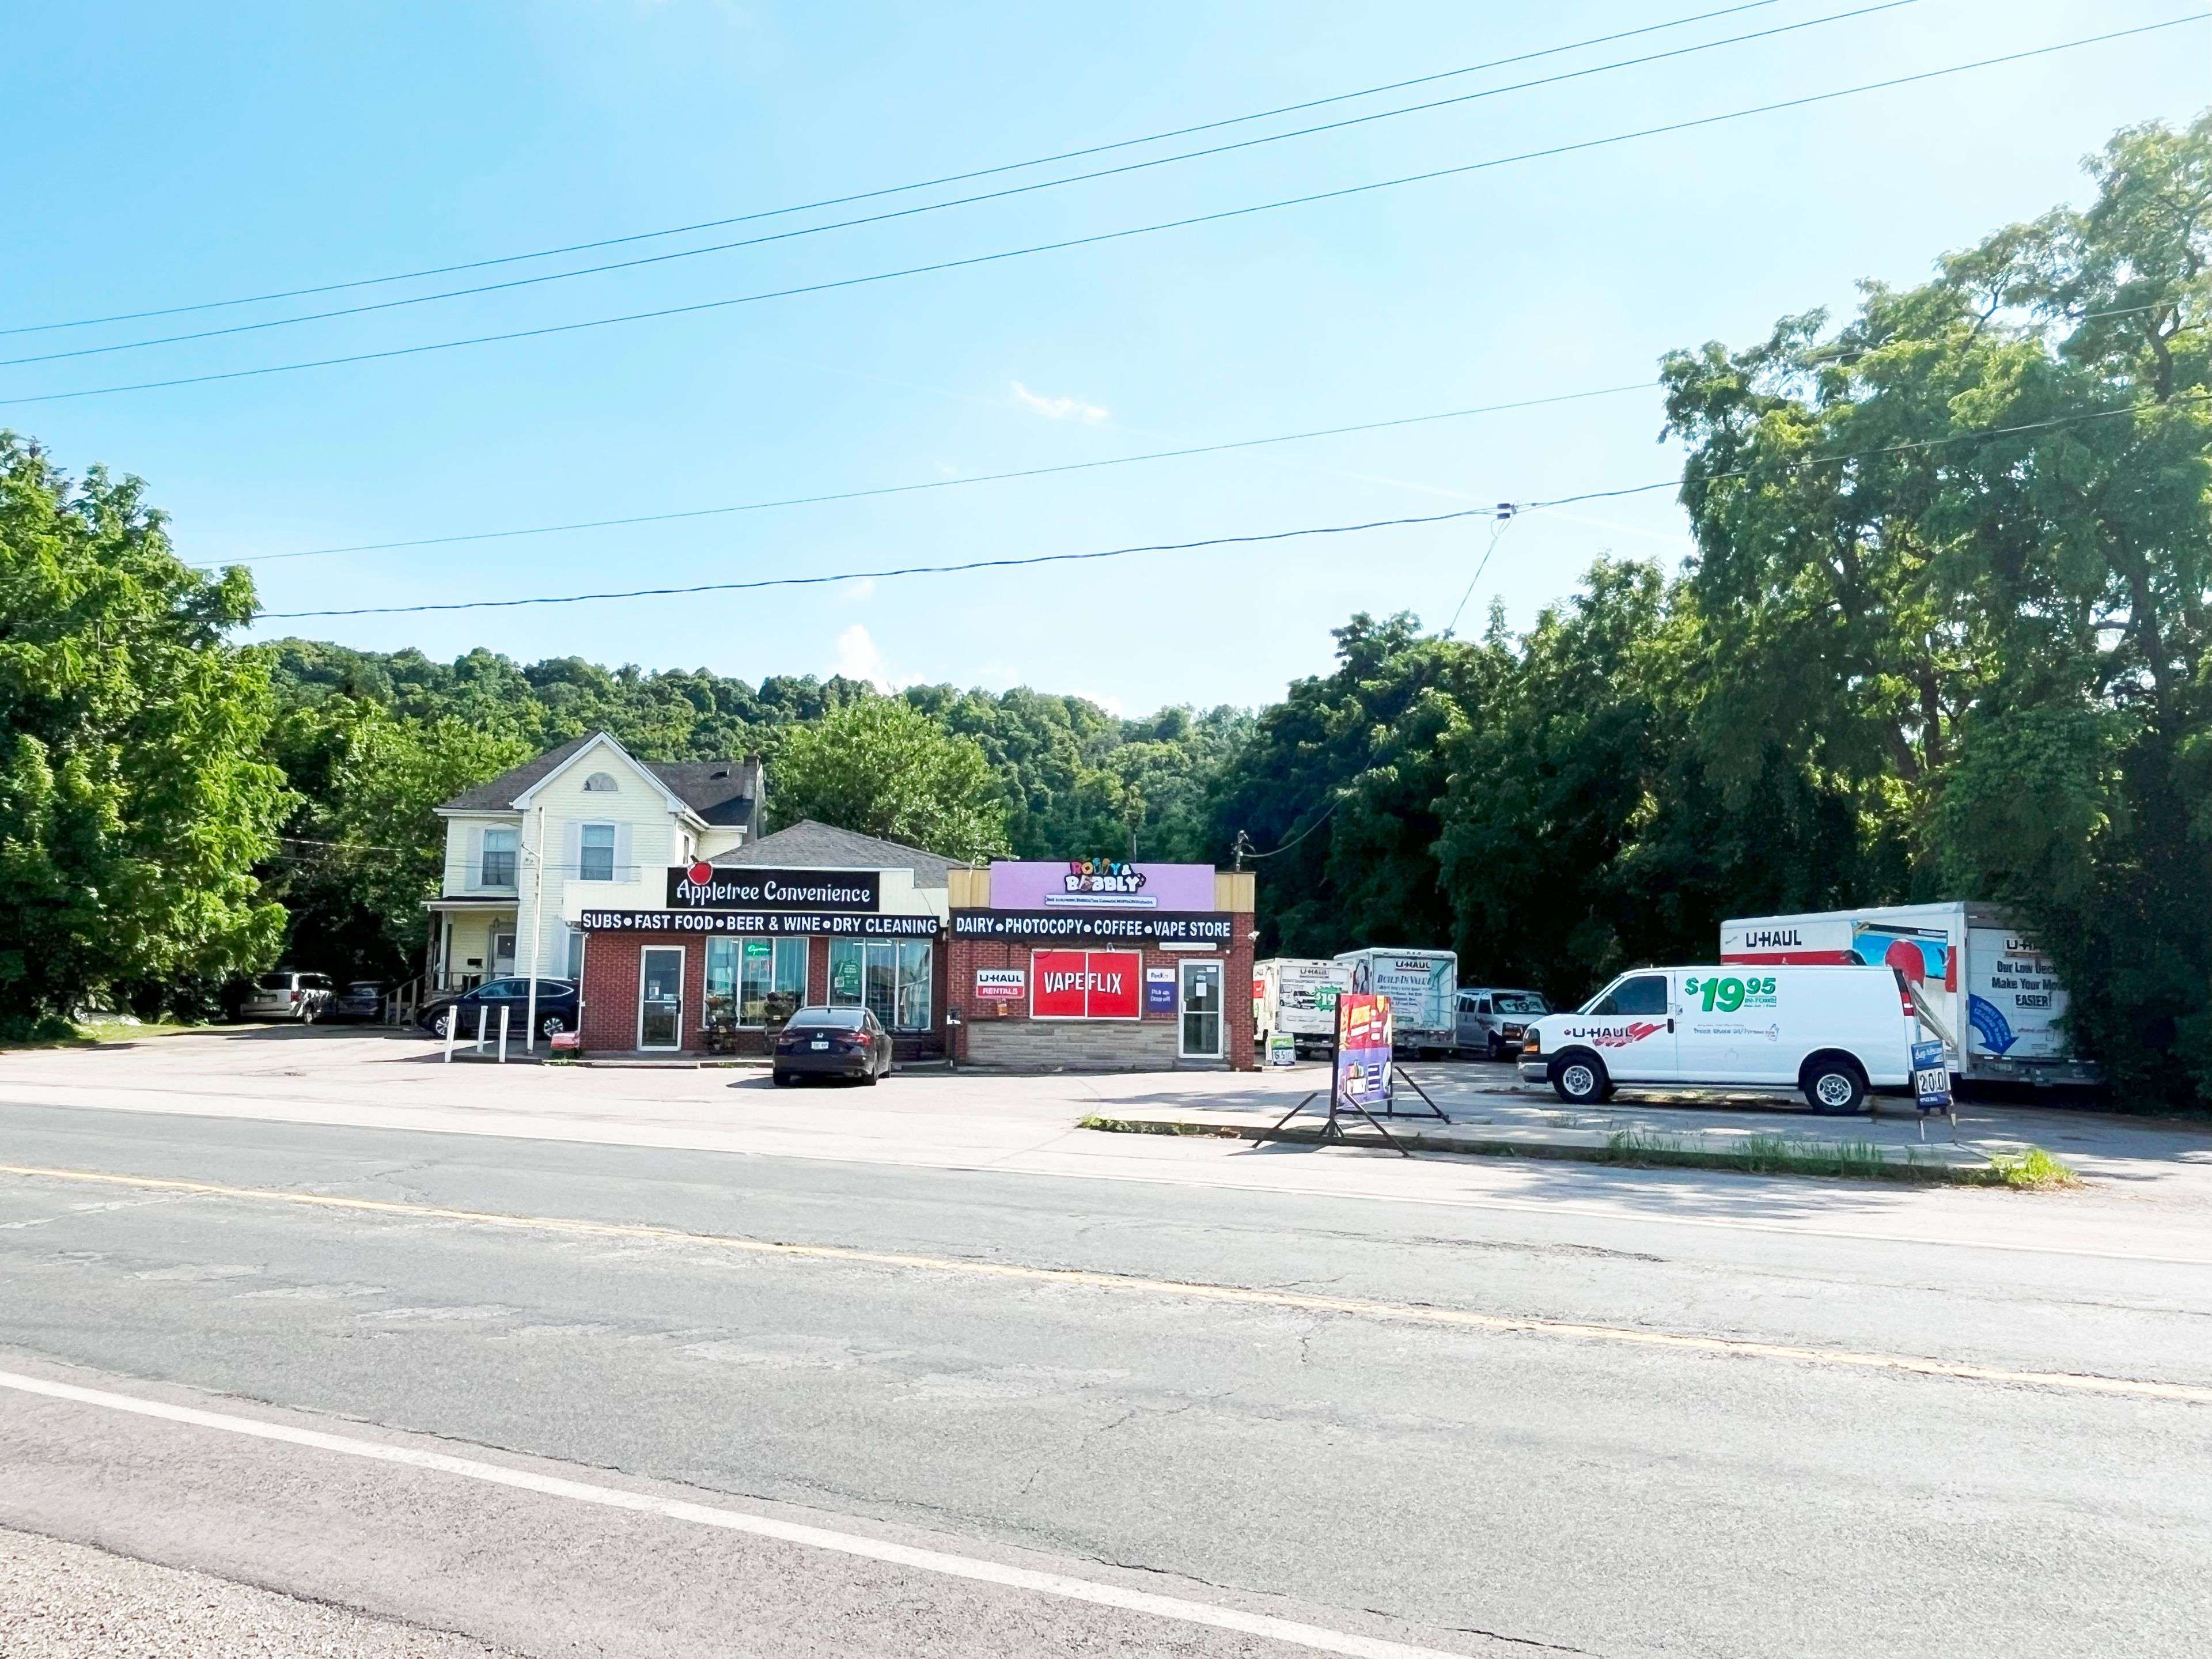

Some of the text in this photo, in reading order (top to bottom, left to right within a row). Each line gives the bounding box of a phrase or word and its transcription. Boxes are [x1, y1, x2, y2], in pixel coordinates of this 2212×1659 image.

[677, 879, 870, 906] Appletree Convenience
[582, 913, 937, 933] SUBS FAST FOOD BEER & WINE DRY CLEANING
[956, 917, 1230, 937] DAIRY PHOTOCOPY COFFEE VAPE STORE
[1746, 929, 1802, 948] U-HAUL
[979, 974, 1022, 983] U-HAUL
[1044, 972, 1122, 995] VAPEFLIX
[1992, 977, 2017, 989] Make
[2020, 978, 2041, 990] Your
[1573, 1027, 1635, 1037] U-HAUL
[1919, 1072, 1944, 1092] 200
